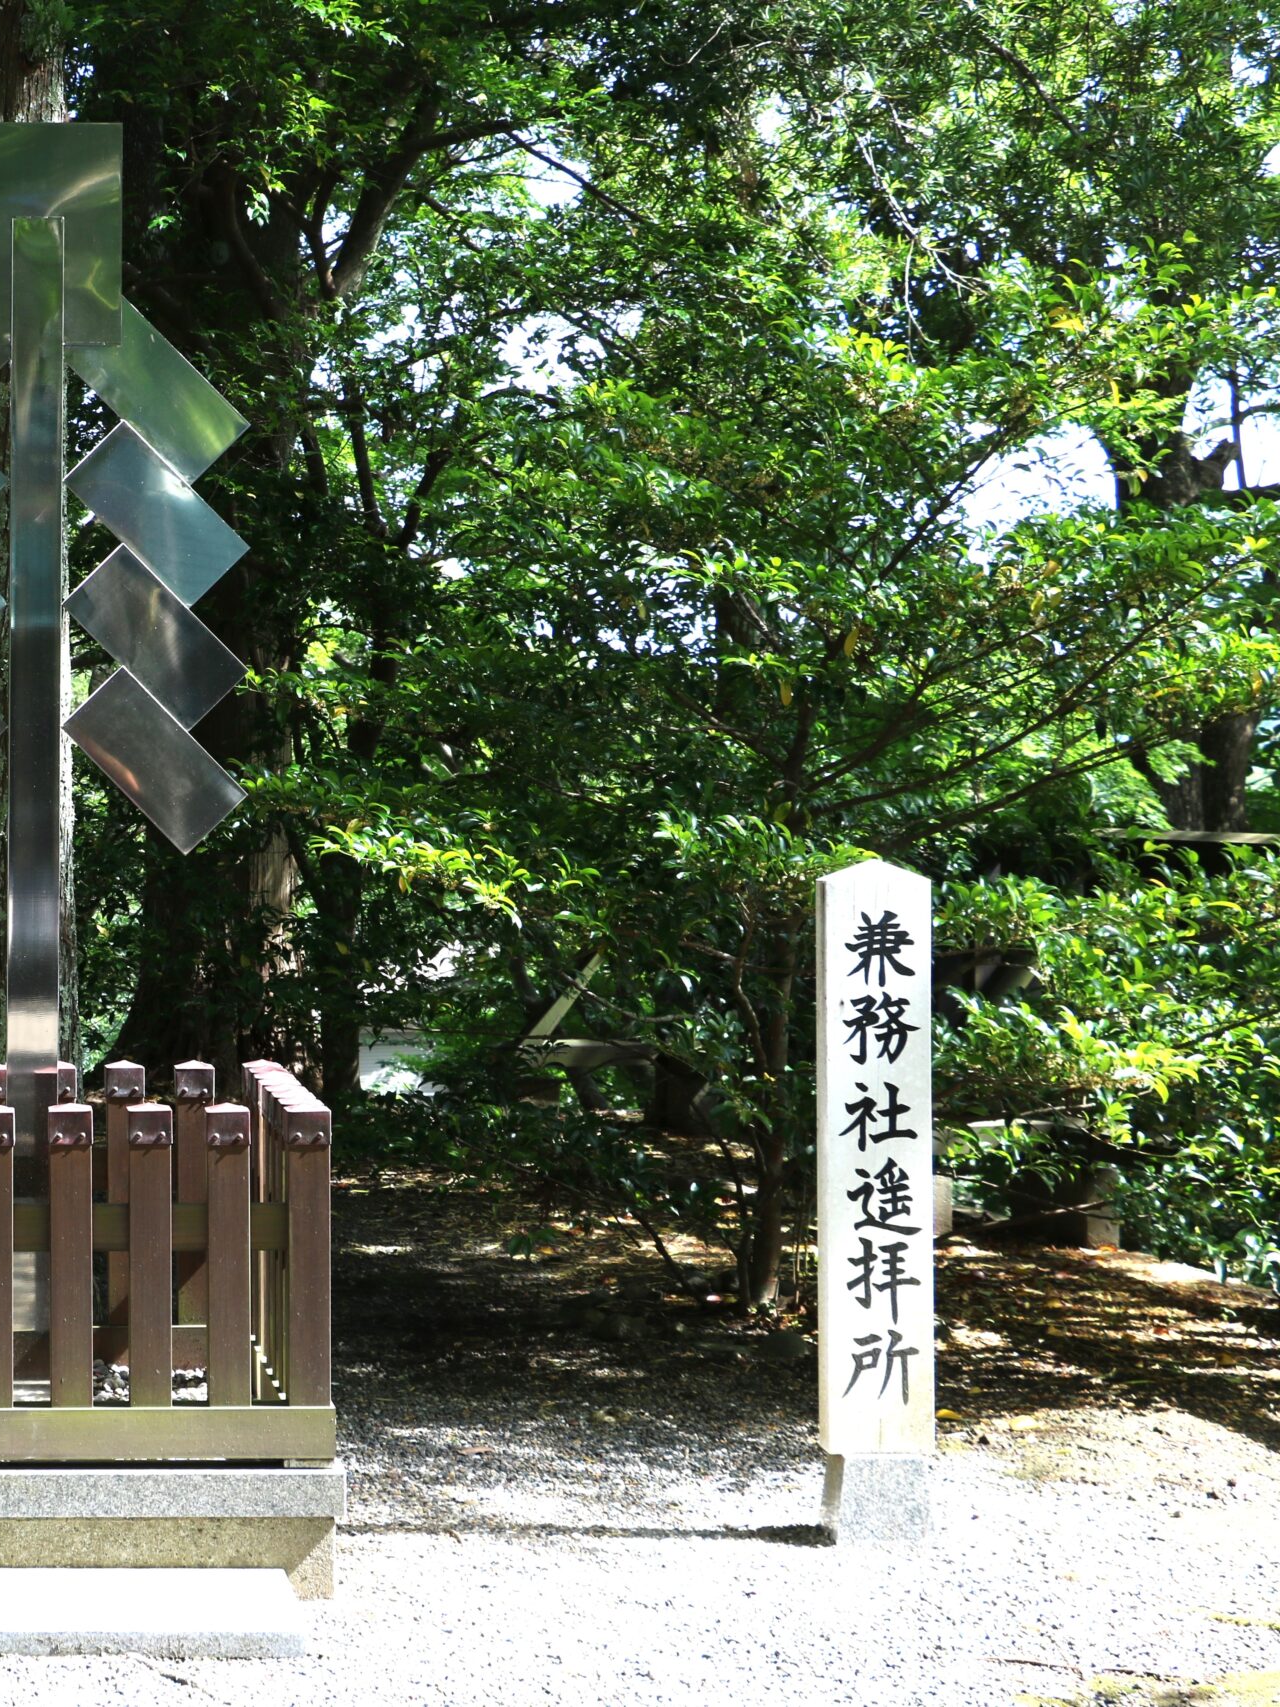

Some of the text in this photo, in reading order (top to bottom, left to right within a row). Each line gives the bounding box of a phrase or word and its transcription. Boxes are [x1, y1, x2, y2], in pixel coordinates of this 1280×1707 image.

[839, 910, 922, 1406] 兼務社遥拝所
